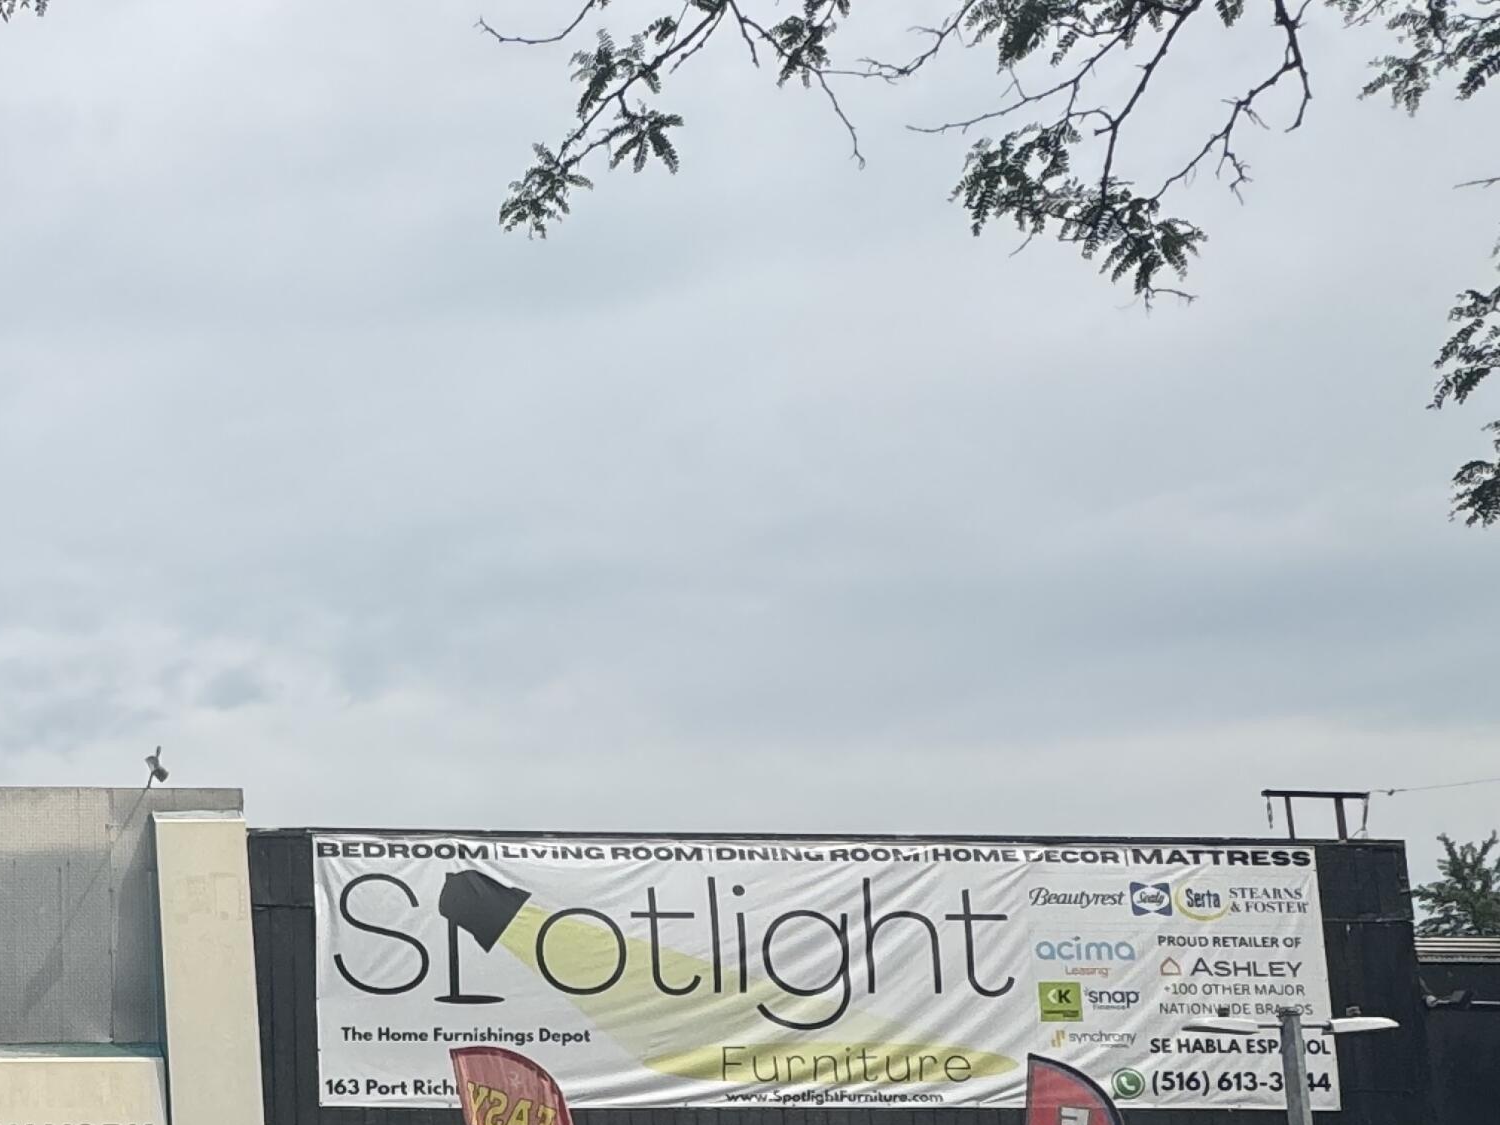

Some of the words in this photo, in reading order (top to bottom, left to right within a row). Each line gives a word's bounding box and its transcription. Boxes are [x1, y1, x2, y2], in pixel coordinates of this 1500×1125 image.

[316, 842, 490, 860] BEDROOM
[502, 844, 605, 860] LIVING
[612, 846, 701, 862] ROOM
[716, 848, 825, 862] DINING
[933, 848, 1019, 863] HOME
[1025, 848, 1120, 864] DECOR
[1132, 849, 1312, 866] MATTRESS
[1029, 887, 1125, 909] Beautyrest
[1185, 890, 1222, 909] Serta
[1228, 887, 1304, 900] STEARNS
[1230, 902, 1241, 914] &
[1245, 901, 1309, 915] FOSTER
[1035, 936, 1136, 961] acima
[1157, 935, 1209, 948] PROUD
[1212, 936, 1280, 949] RETAILER
[1283, 936, 1303, 949] OF
[1190, 957, 1303, 978] ASHLEY
[1088, 988, 1140, 1009] snap
[1163, 983, 1198, 996] +100
[1202, 984, 1250, 997] OTHER
[1254, 984, 1306, 997] MAJOR
[1159, 1002, 1251, 1016] NATIONWDE
[1255, 1003, 1314, 1016] BRADS
[341, 1026, 373, 1042] The
[377, 1027, 428, 1043] Home
[433, 1027, 534, 1046] Furnishings
[538, 1028, 591, 1047] Depot
[1068, 1030, 1137, 1046] synchrony
[1150, 1038, 1172, 1055] SE
[1177, 1038, 1242, 1055] HABLA
[1246, 1038, 1332, 1055] ESPOL
[721, 1046, 973, 1083] Furniture
[325, 1079, 360, 1096] 163
[366, 1079, 408, 1096] Port
[413, 1079, 460, 1096] Rich
[1151, 1070, 1210, 1097] (516)
[1217, 1071, 1332, 1092] 613-344
